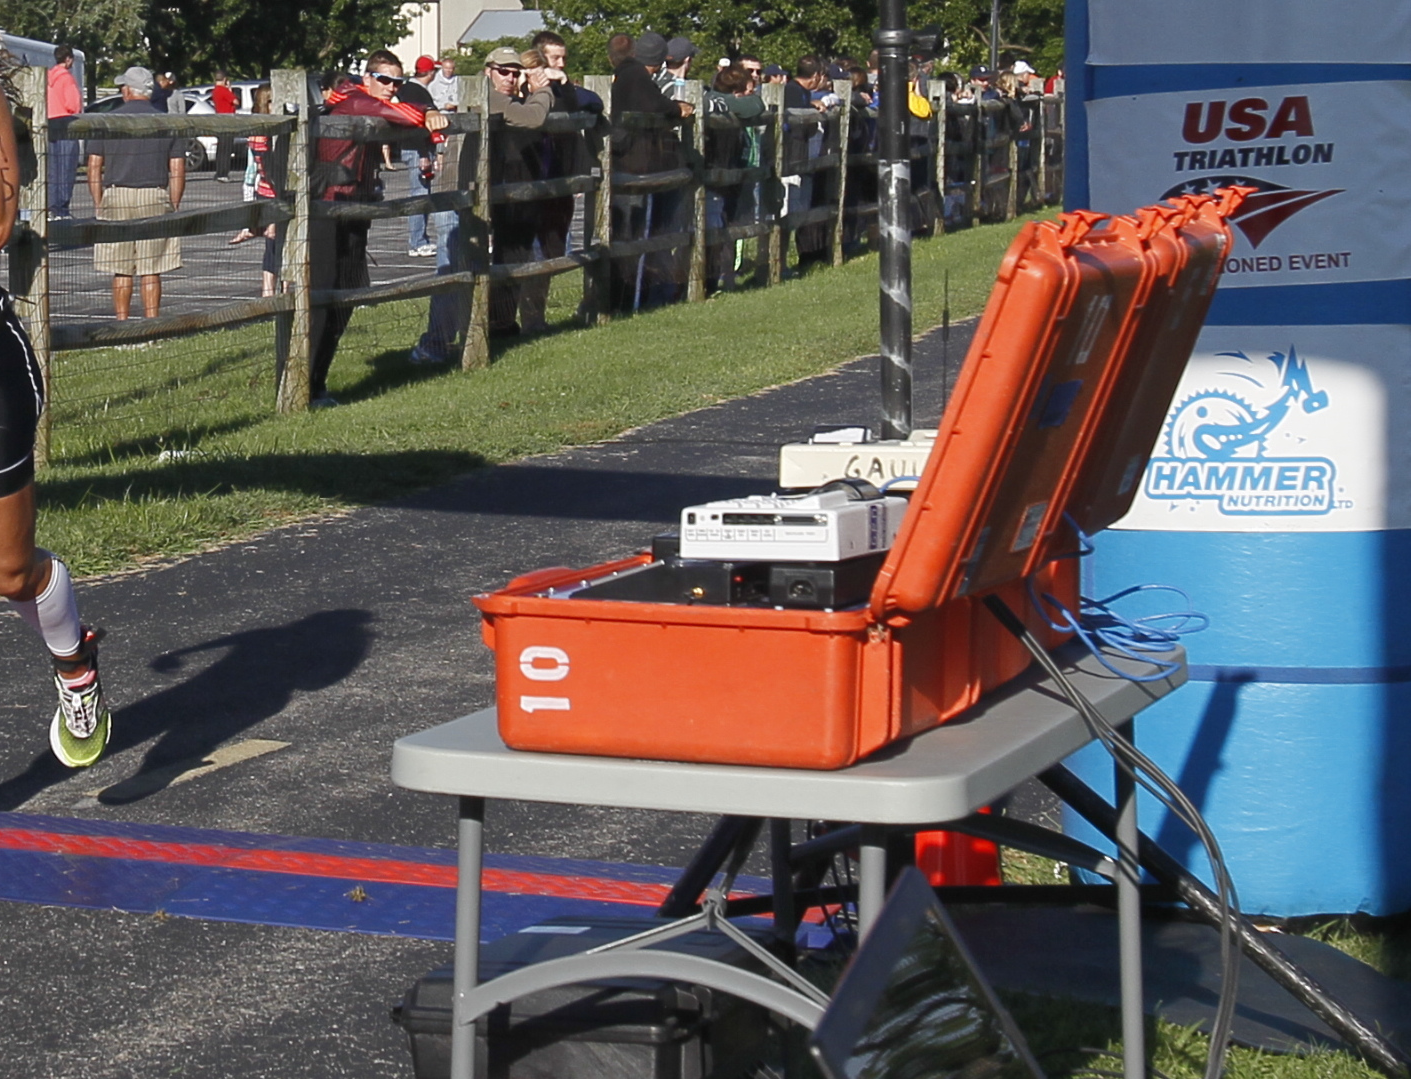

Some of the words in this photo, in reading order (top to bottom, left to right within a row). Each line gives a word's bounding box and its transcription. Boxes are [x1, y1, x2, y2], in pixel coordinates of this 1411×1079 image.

[1181, 95, 1315, 144] USA
[1173, 143, 1335, 172] TRIATHLON
[1289, 252, 1351, 270] EVENT
[1152, 465, 1328, 491] HAMMER
[1226, 494, 1326, 508] NUTRITION
[519, 646, 570, 713] 10
